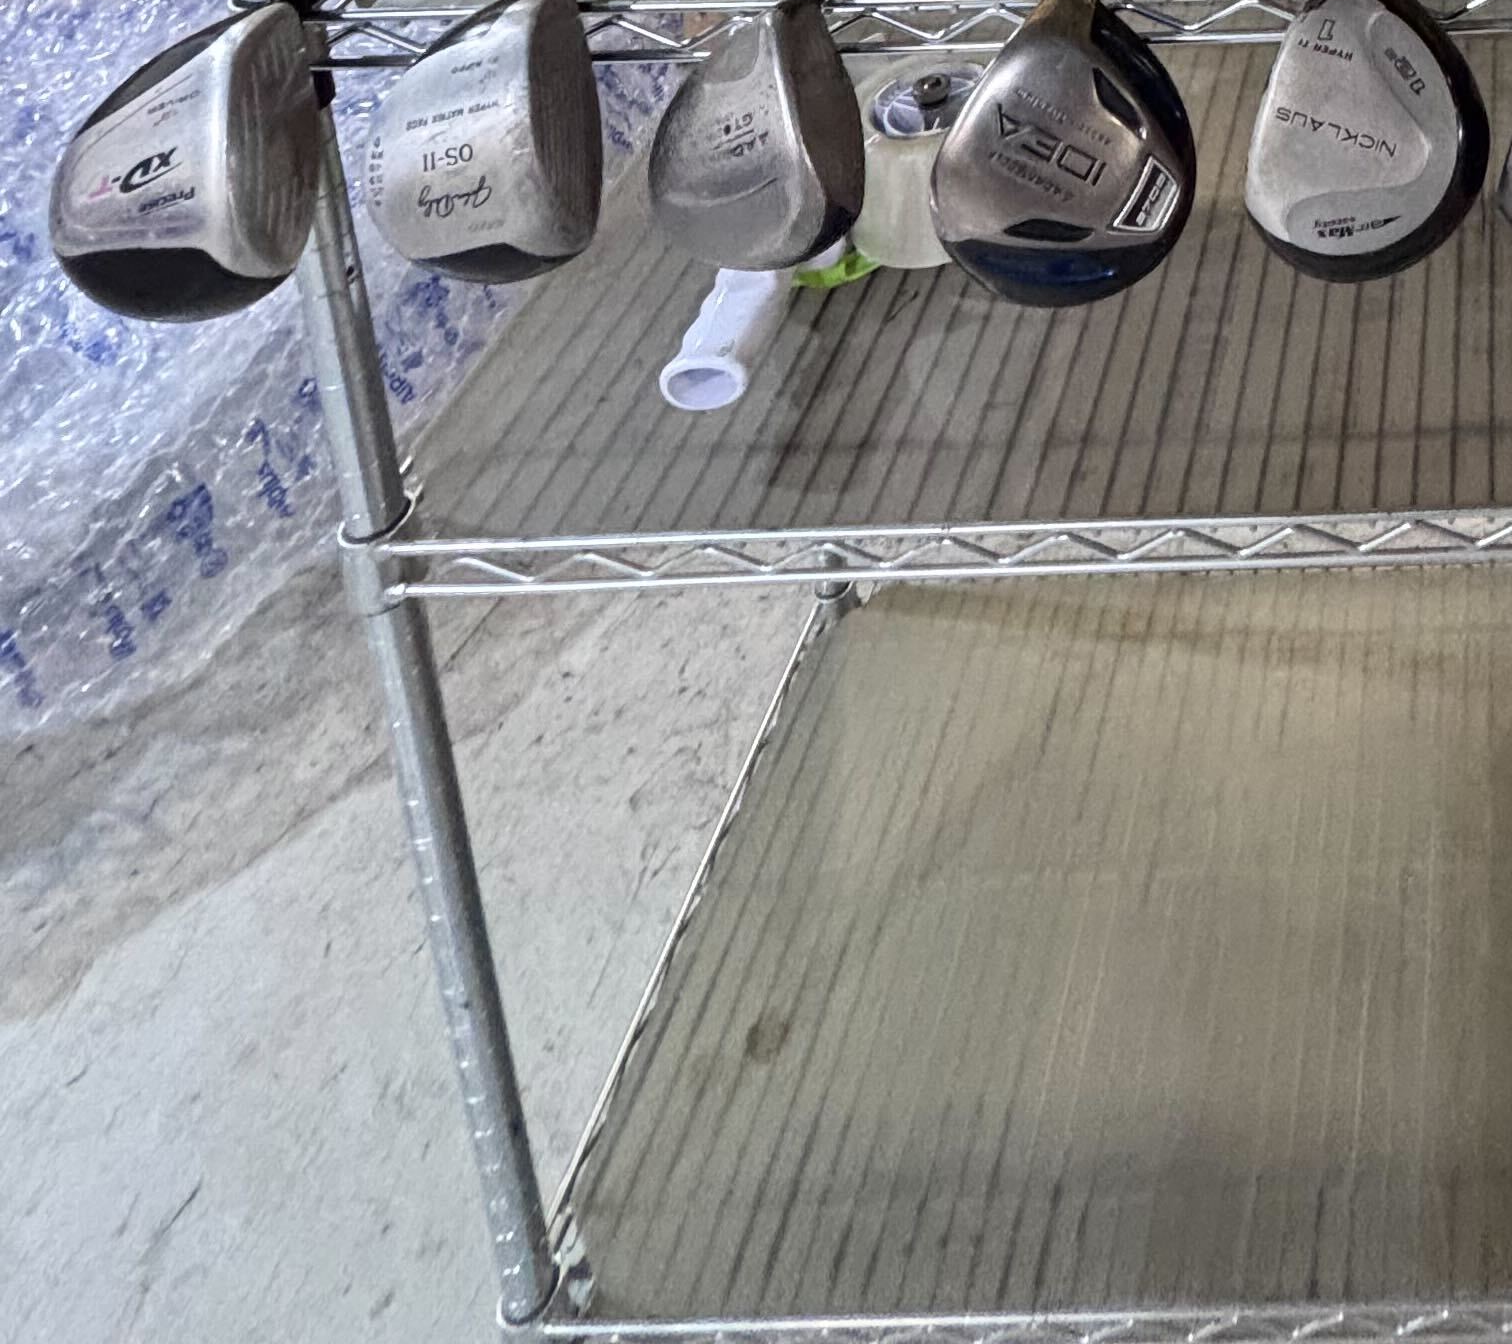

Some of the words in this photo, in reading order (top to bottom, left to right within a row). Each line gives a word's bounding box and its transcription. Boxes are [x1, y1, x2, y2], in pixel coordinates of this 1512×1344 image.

[1312, 42, 1354, 63] HYPER
[997, 104, 1107, 187] IDEA
[1275, 106, 1398, 159] NICKLAUS
[421, 143, 474, 173] OS-II
